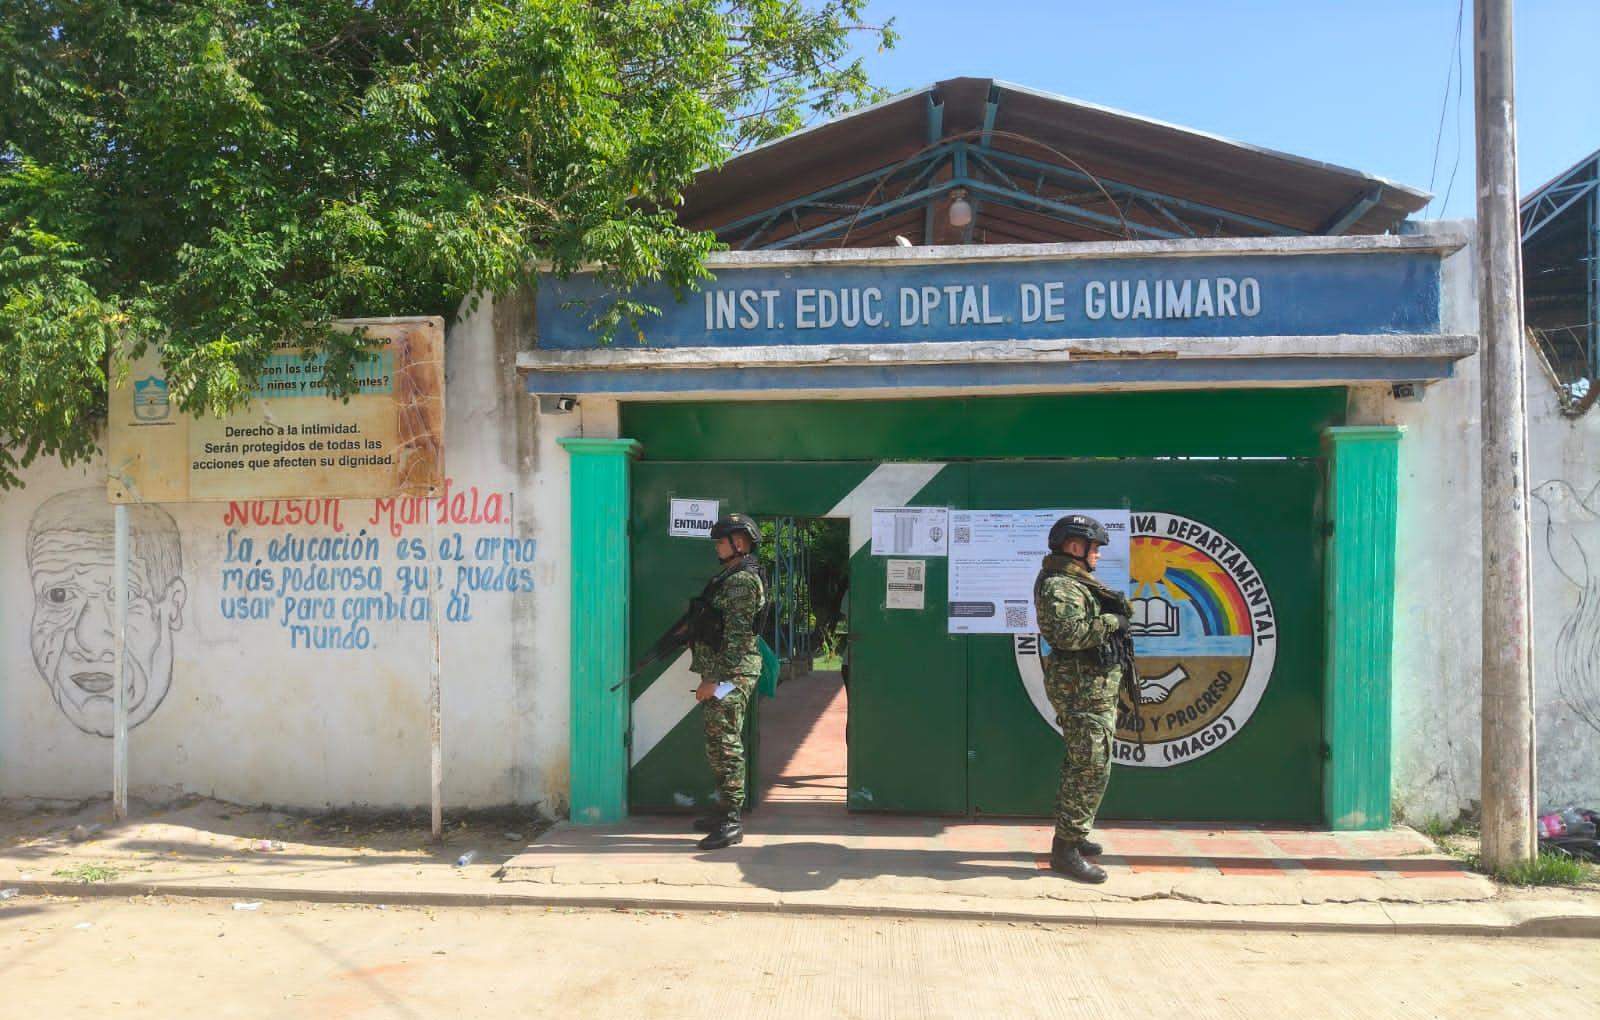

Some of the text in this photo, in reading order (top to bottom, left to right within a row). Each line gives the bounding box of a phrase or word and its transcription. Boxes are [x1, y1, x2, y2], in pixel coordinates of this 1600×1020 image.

[705, 290, 785, 330] INST.
[796, 287, 889, 328] EDUC.
[1021, 281, 1066, 323] DE
[1084, 277, 1263, 321] GUAIMARO
[267, 377, 296, 390] niñas
[299, 380, 307, 392] y
[284, 363, 301, 374] los
[225, 423, 361, 438] Derecho a la intimidad.
[192, 455, 396, 472] acciones que afecten su dignidad.
[204, 439, 382, 456] Serán protegidos de todas las
[674, 518, 715, 530] ENTRADA
[224, 529, 538, 564] La educación es el arma
[221, 559, 275, 592] más
[275, 563, 382, 598] poderosa
[455, 562, 536, 598] puedes
[1167, 519, 1275, 647] DEPARTAMENTAL
[220, 595, 275, 620] usar
[280, 597, 336, 627] para
[289, 618, 378, 650] mundo.
[1151, 671, 1233, 731] Y PROGRESO
[1163, 714, 1238, 762] (MAGD)
